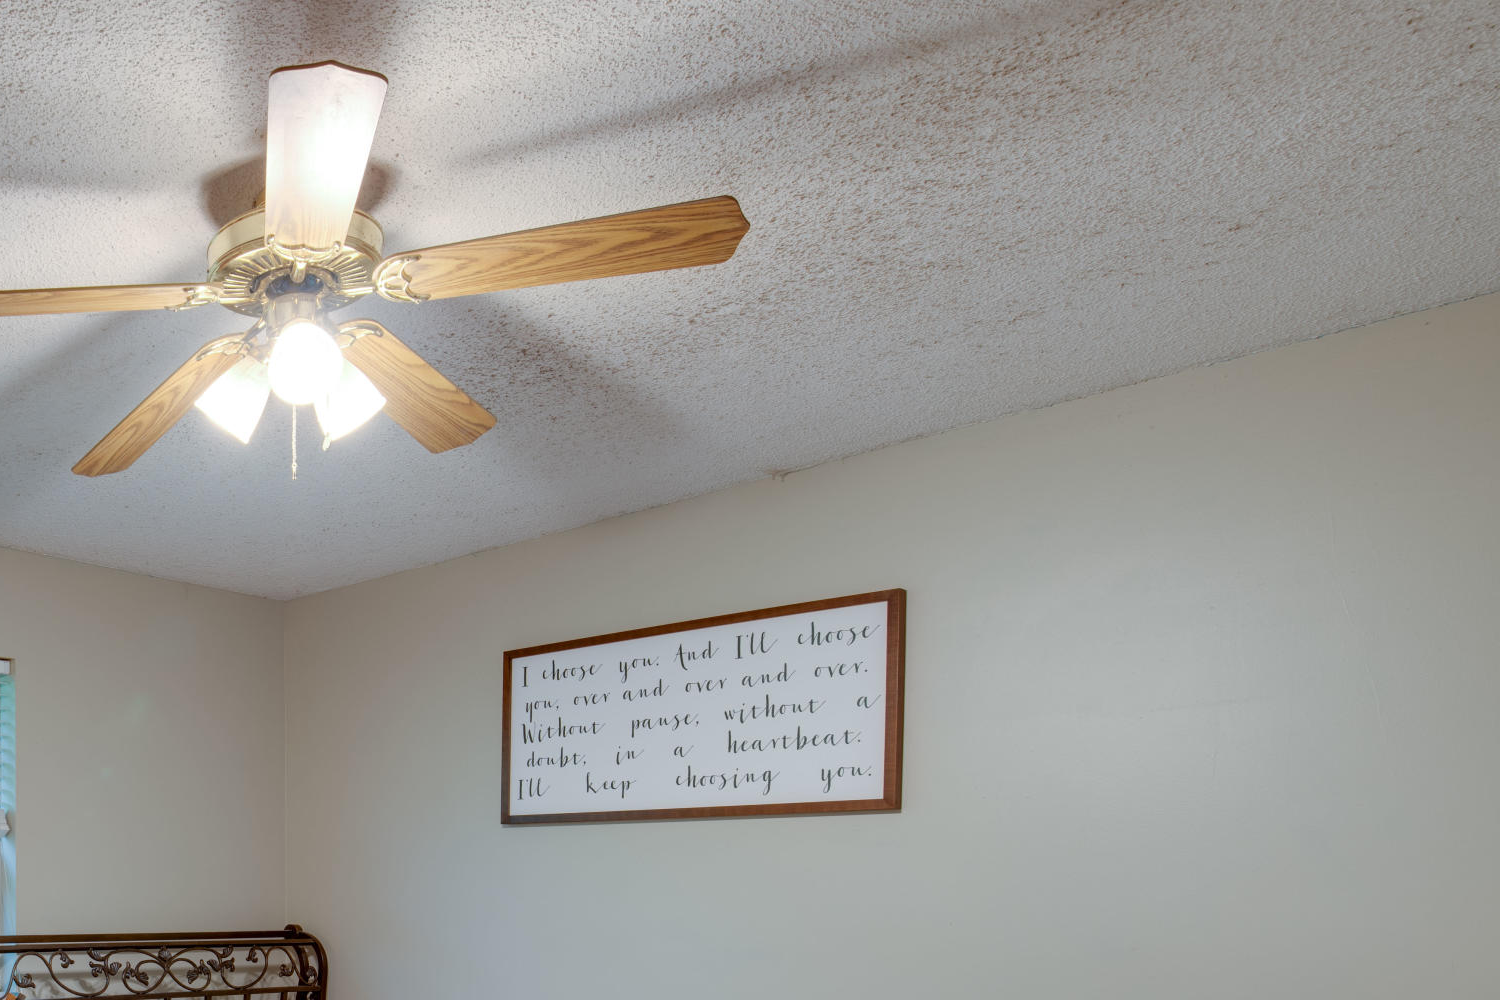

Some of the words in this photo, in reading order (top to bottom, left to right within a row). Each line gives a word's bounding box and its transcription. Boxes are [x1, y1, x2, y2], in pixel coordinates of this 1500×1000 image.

[522, 666, 529, 687] I
[542, 660, 602, 681] choose
[619, 655, 659, 683] you.
[674, 641, 719, 671] And
[735, 632, 778, 660] I'll
[797, 622, 881, 646] choose
[525, 699, 560, 722] you,
[573, 692, 610, 706] over
[623, 679, 670, 701] and
[685, 677, 727, 693] over
[742, 663, 796, 686] and
[814, 662, 868, 678] over.
[522, 718, 606, 745] Without
[631, 712, 699, 737] pause,
[724, 695, 826, 724] without
[856, 694, 881, 709] a
[526, 747, 586, 768] doubt,
[616, 745, 645, 765] in
[674, 744, 694, 758] a
[727, 726, 861, 753] heartbeat.
[518, 779, 550, 800] I'll
[586, 773, 636, 798] keep
[676, 766, 780, 795] choosing
[821, 764, 872, 793] you.
